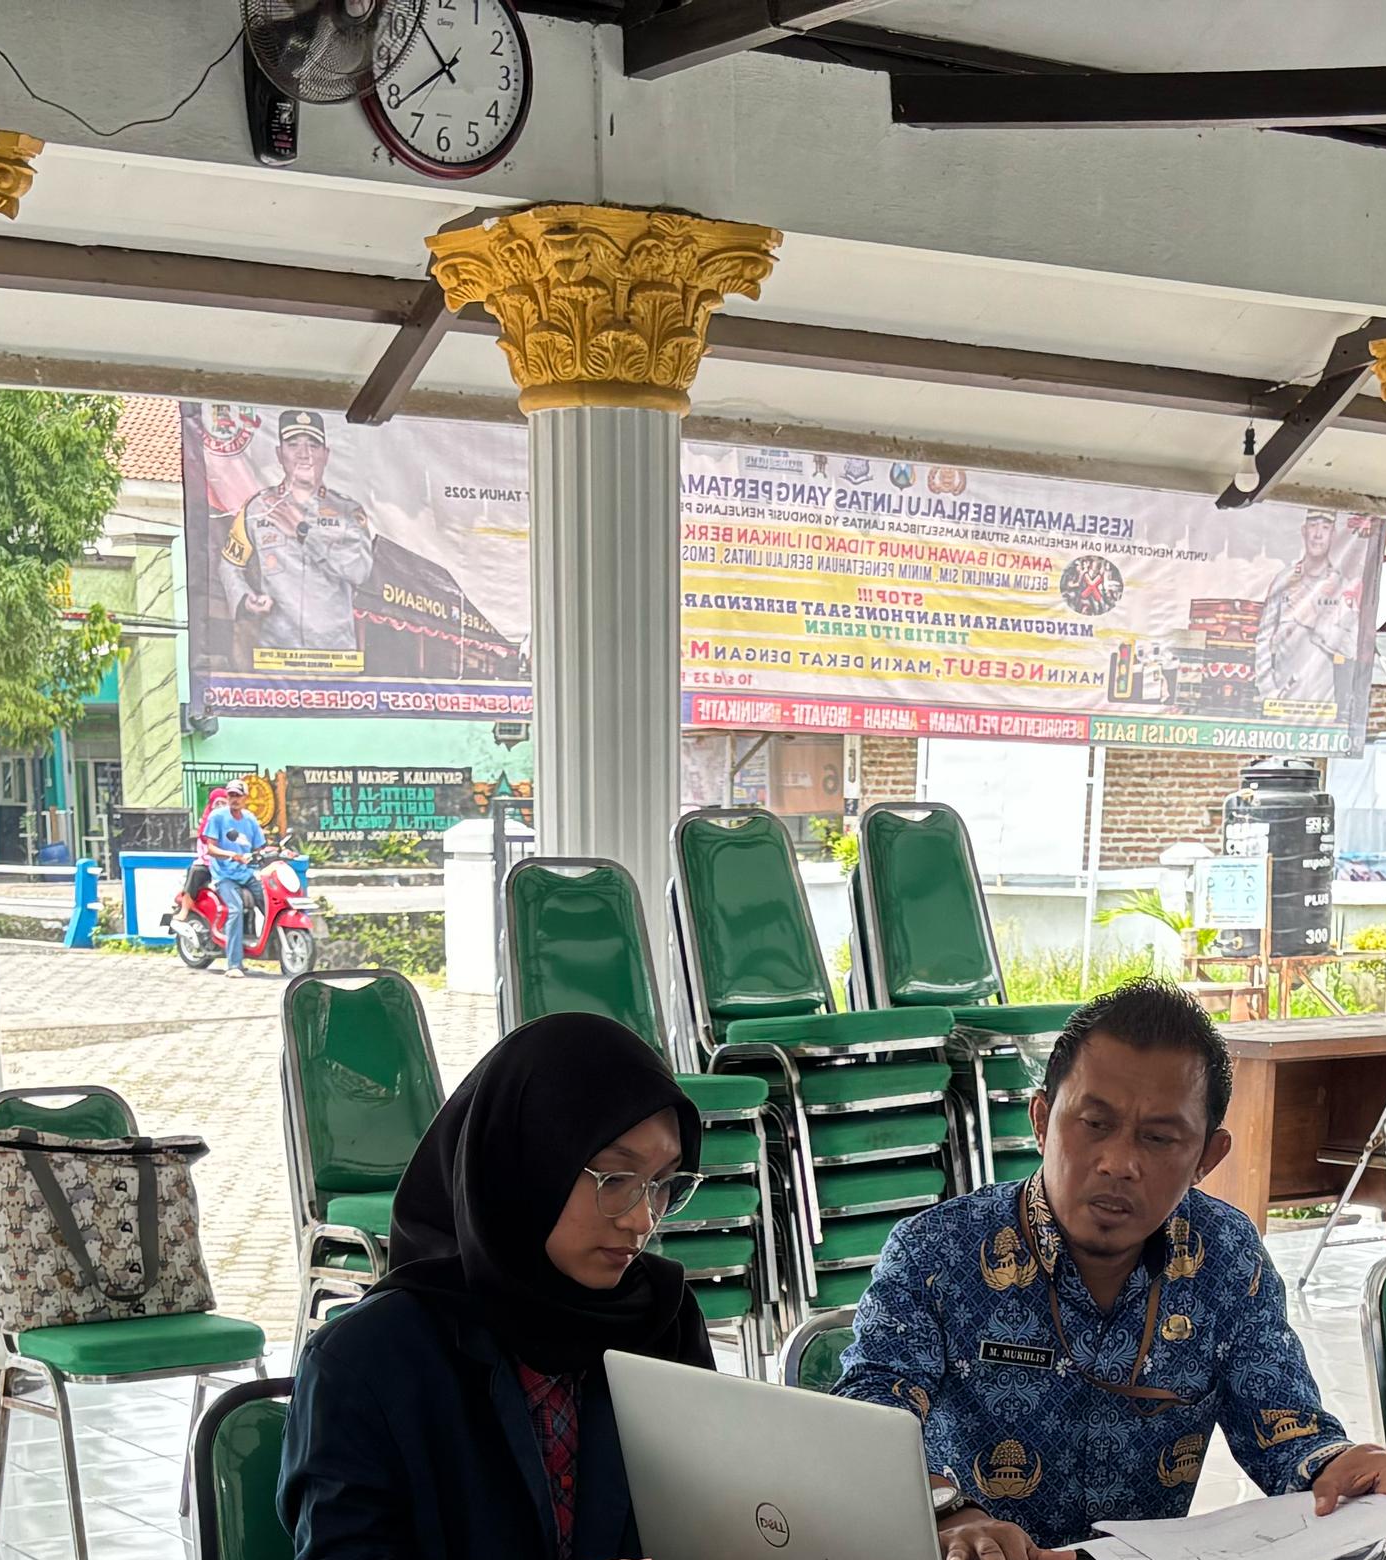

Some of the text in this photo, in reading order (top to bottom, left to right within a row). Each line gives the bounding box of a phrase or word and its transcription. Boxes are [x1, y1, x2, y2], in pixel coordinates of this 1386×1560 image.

[490, 30, 504, 56] 2
[498, 65, 511, 91] 3
[387, 83, 401, 110] 8
[410, 111, 425, 138] 7
[485, 99, 501, 126] 4
[436, 126, 451, 152] 6
[466, 121, 479, 147] 5
[304, 770, 353, 784] YAYASAN
[1305, 928, 1328, 944] 300
[989, 1347, 1047, 1363] M. MUKHLIS
[759, 1517, 787, 1534] DELL
